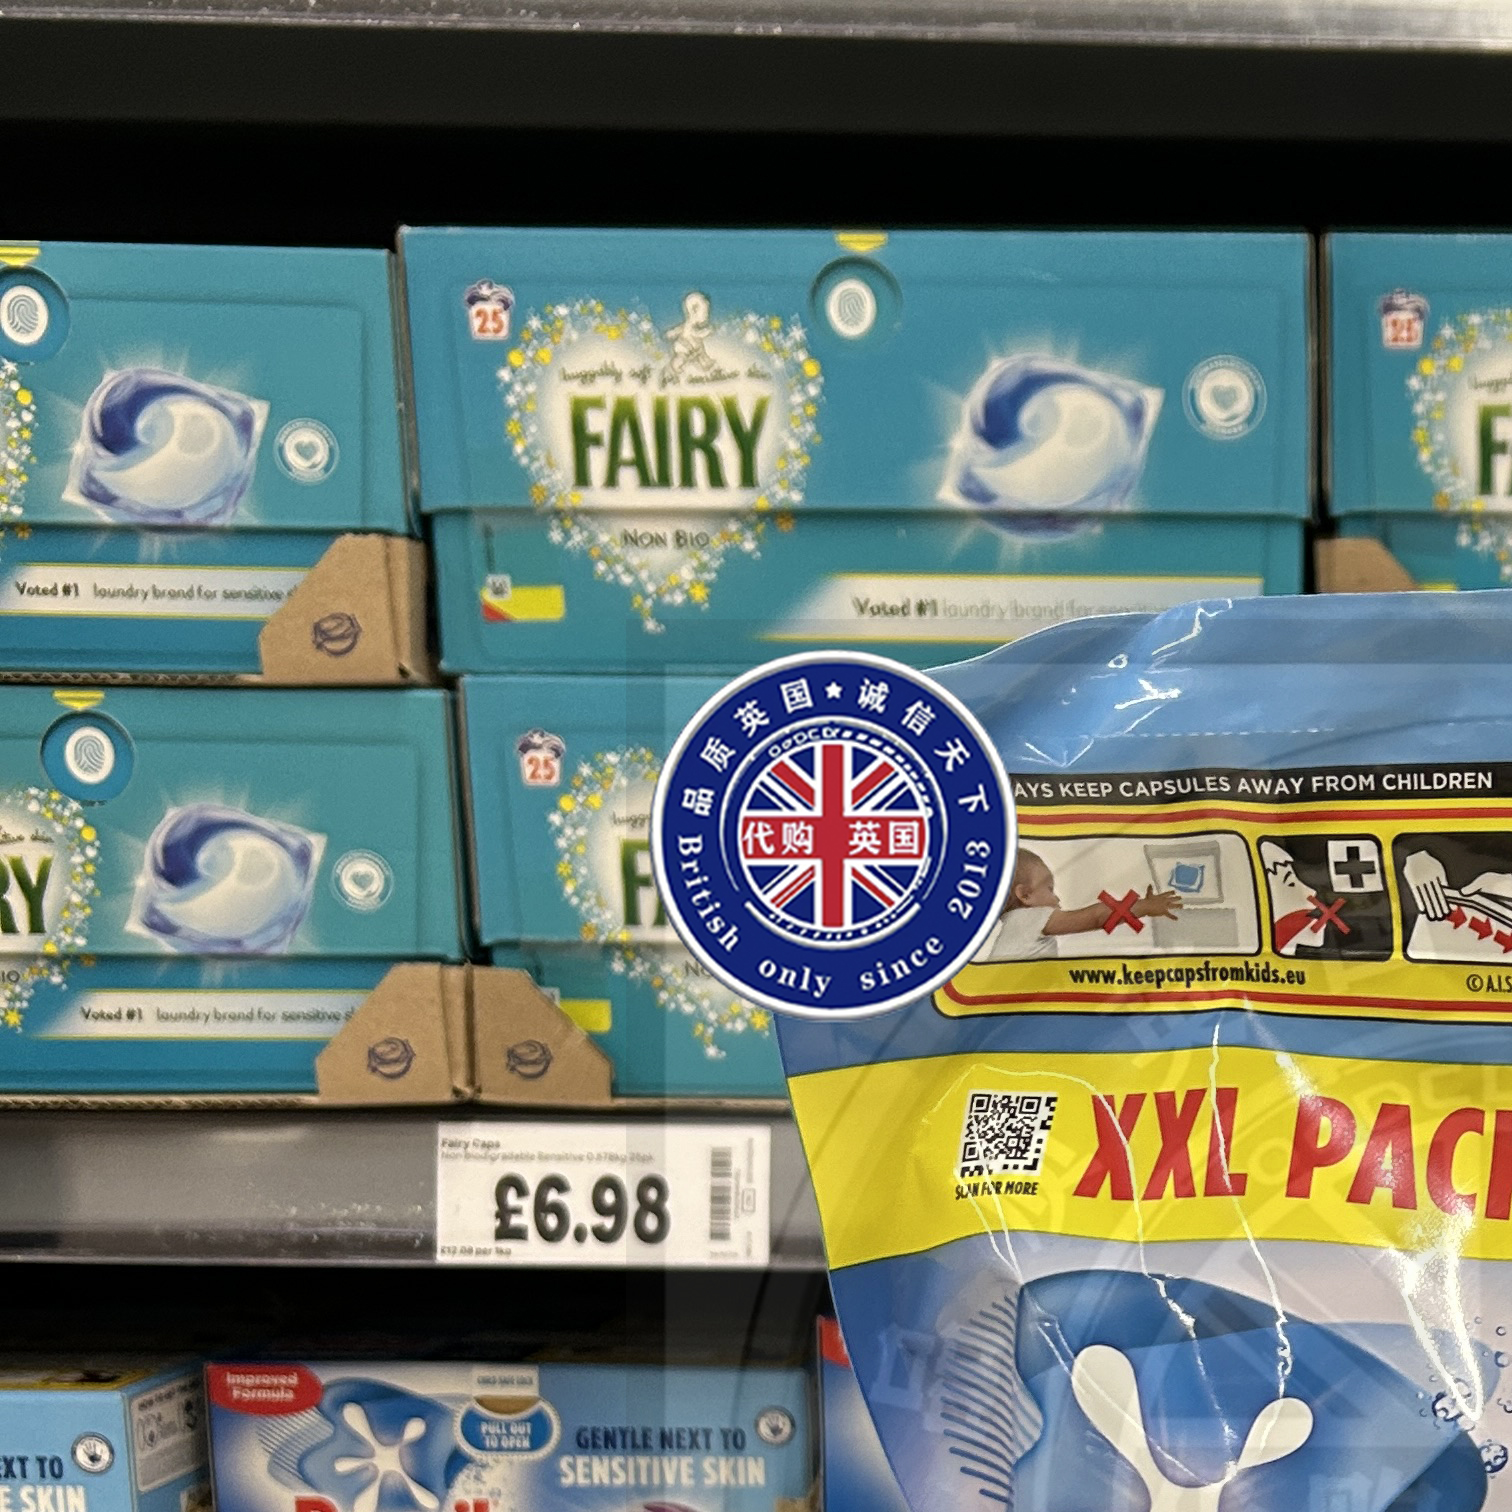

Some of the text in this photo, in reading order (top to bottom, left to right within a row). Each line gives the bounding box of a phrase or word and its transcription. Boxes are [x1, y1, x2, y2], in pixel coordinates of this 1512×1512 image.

[474, 308, 505, 333] 25
[569, 395, 773, 489] FAIRY
[622, 529, 711, 549] NON BIO
[15, 581, 60, 598] Voted
[853, 597, 912, 619] Voted
[526, 755, 557, 782] 25
[1059, 771, 1494, 799] KEEP CAPSULES AWAY FROM CHILDREN
[1068, 963, 1307, 989] www.keepcapsfromkids.eu
[81, 1006, 124, 1022] Voted
[126, 1007, 144, 1021] #1
[1073, 1085, 1249, 1202] XXL
[1003, 1180, 1039, 1197] MORE
[493, 1171, 672, 1245] £6.98
[226, 1371, 299, 1388] Improved
[232, 1385, 295, 1401] Formula
[576, 1426, 746, 1451] GENTLE NEXT TO
[35, 1456, 64, 1480] TO
[559, 1455, 766, 1488] SENSITIVE SKIN
